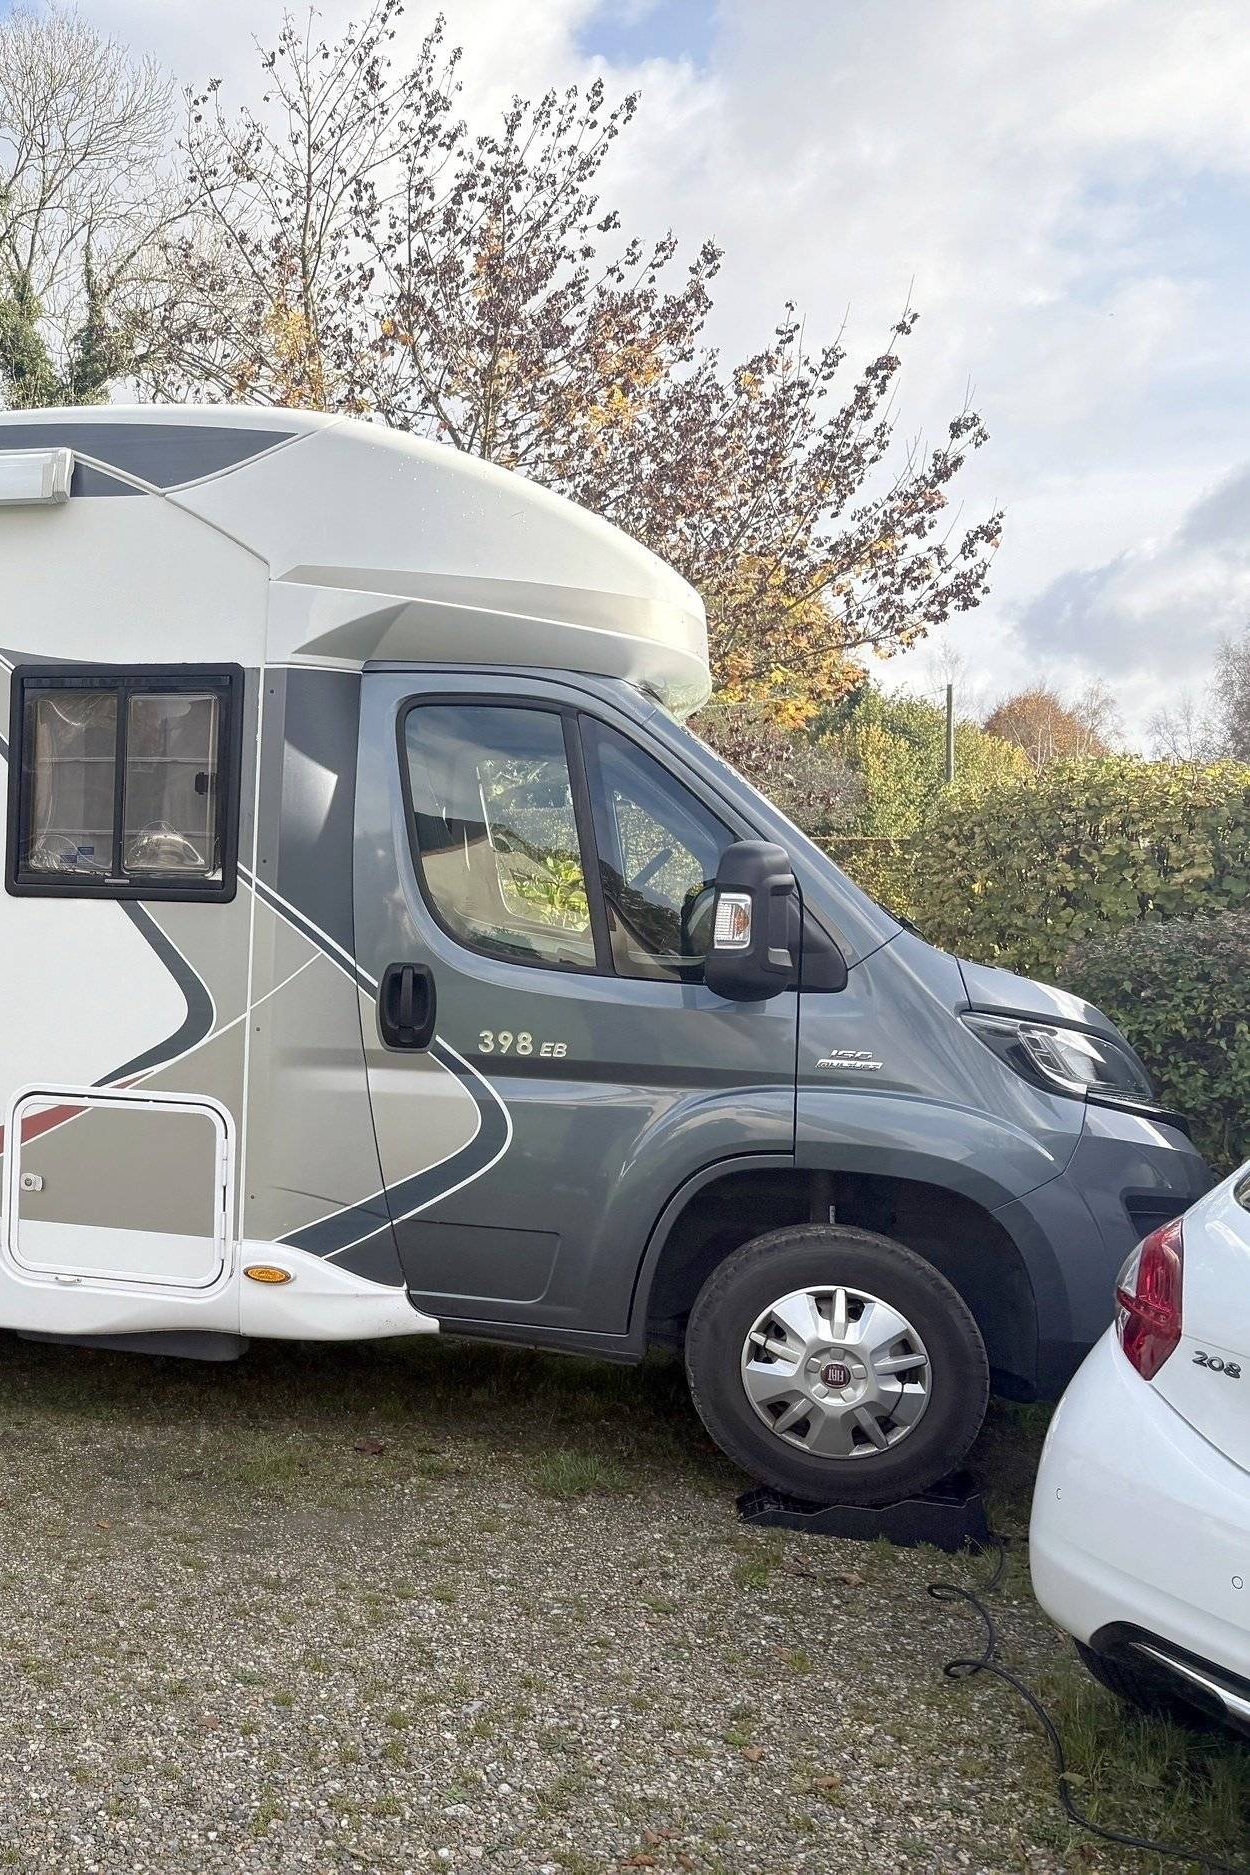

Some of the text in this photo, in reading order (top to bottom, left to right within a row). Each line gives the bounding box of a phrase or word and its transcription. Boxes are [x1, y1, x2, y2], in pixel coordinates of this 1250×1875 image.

[478, 1030, 568, 1058] 398 EB
[827, 1368, 845, 1382] FIAT
[1191, 1350, 1242, 1379] 208
